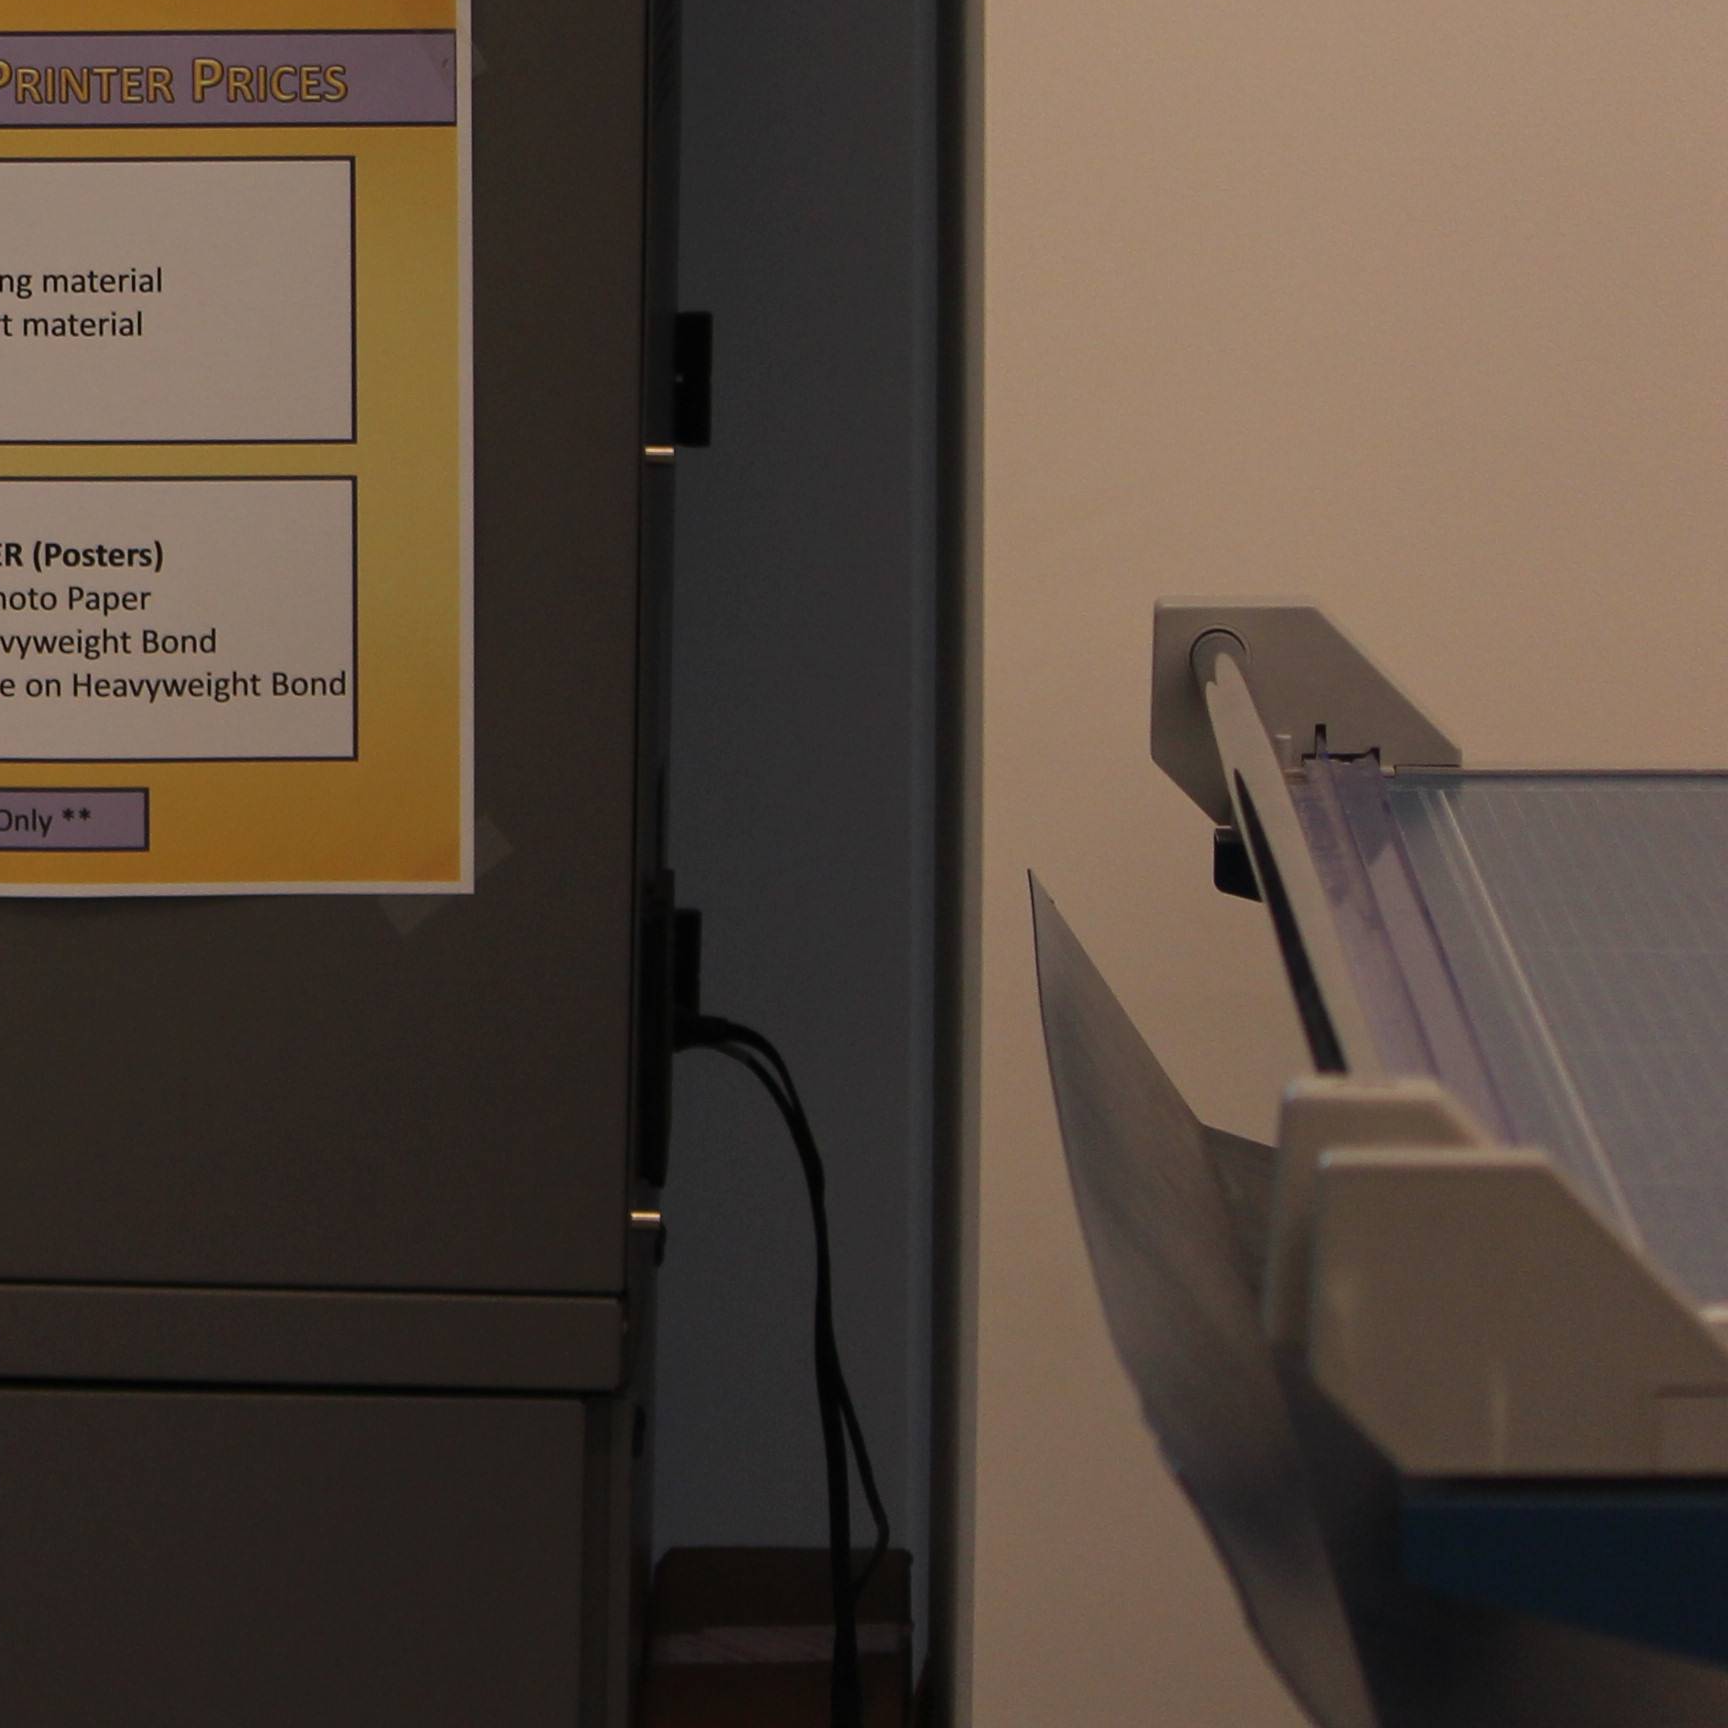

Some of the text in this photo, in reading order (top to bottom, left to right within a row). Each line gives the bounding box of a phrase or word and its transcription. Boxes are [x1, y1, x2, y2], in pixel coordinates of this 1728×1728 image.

[191, 56, 349, 104] PRICES
[42, 266, 162, 294] material
[23, 310, 143, 337] material
[33, 539, 164, 573] (Posters)
[68, 585, 152, 617] Paper
[142, 627, 217, 655] Bond
[25, 678, 62, 698] on
[72, 670, 262, 704] Heavyweight
[272, 669, 346, 697] Bond
